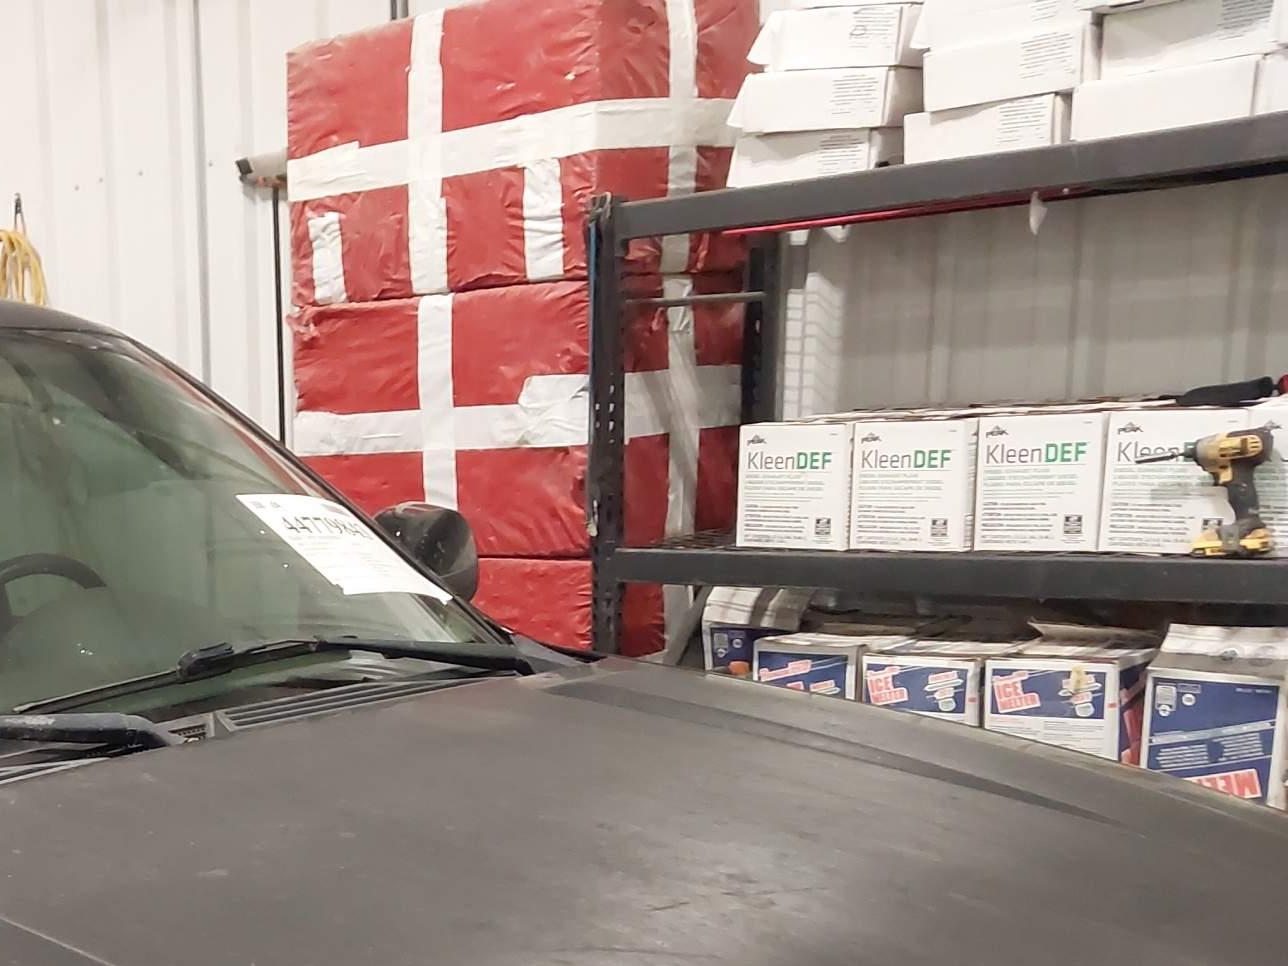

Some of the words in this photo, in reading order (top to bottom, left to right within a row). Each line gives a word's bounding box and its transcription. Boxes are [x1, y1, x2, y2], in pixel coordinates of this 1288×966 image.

[747, 451, 832, 470] KleenDEF
[861, 449, 951, 469] KleenDEF
[985, 442, 1089, 464] KleenDEF
